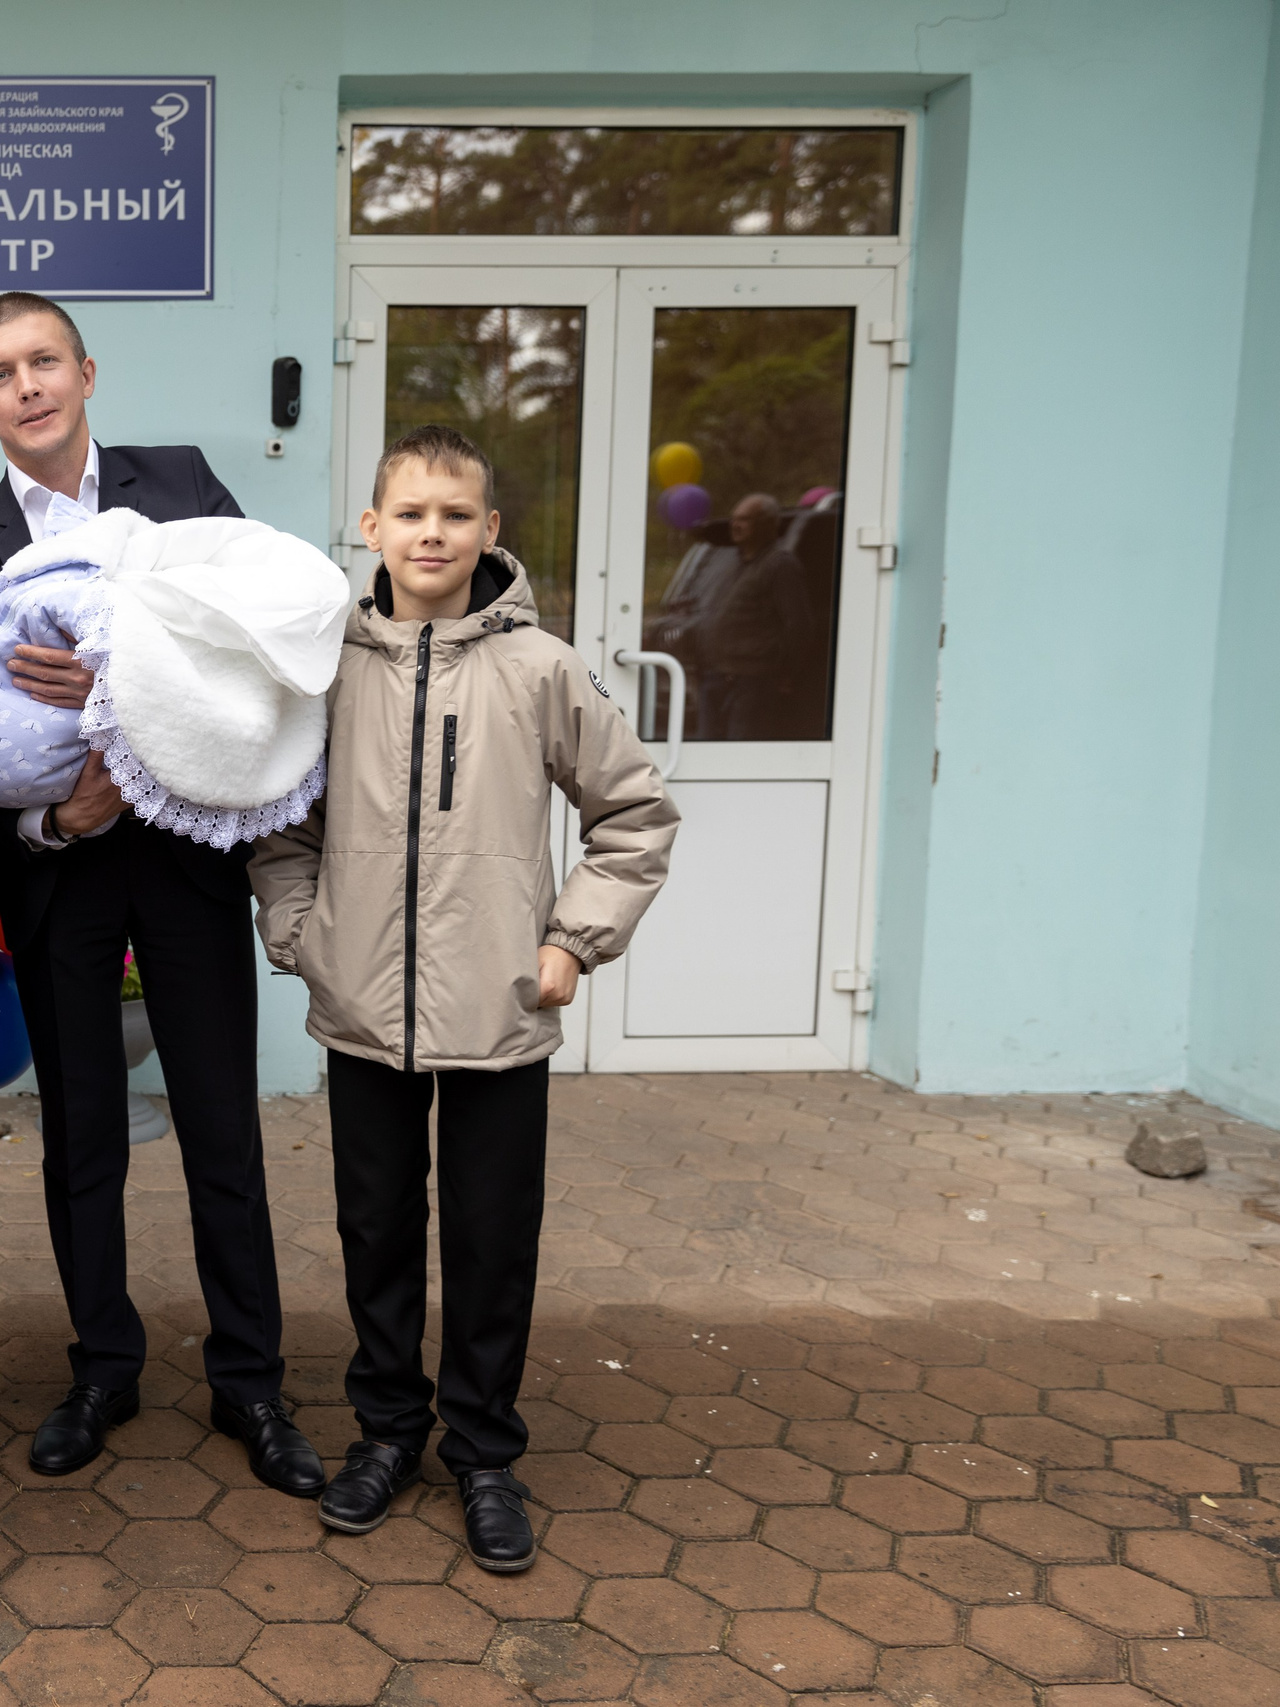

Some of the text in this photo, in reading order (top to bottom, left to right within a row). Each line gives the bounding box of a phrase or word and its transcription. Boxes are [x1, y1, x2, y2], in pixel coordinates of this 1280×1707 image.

[8, 105, 97, 118] ЗАБАЙКАЛЬСКОГО
[99, 107, 124, 117] КРАЯ
[9, 122, 106, 134] ЗДРАВООХРАНЕНИЯ
